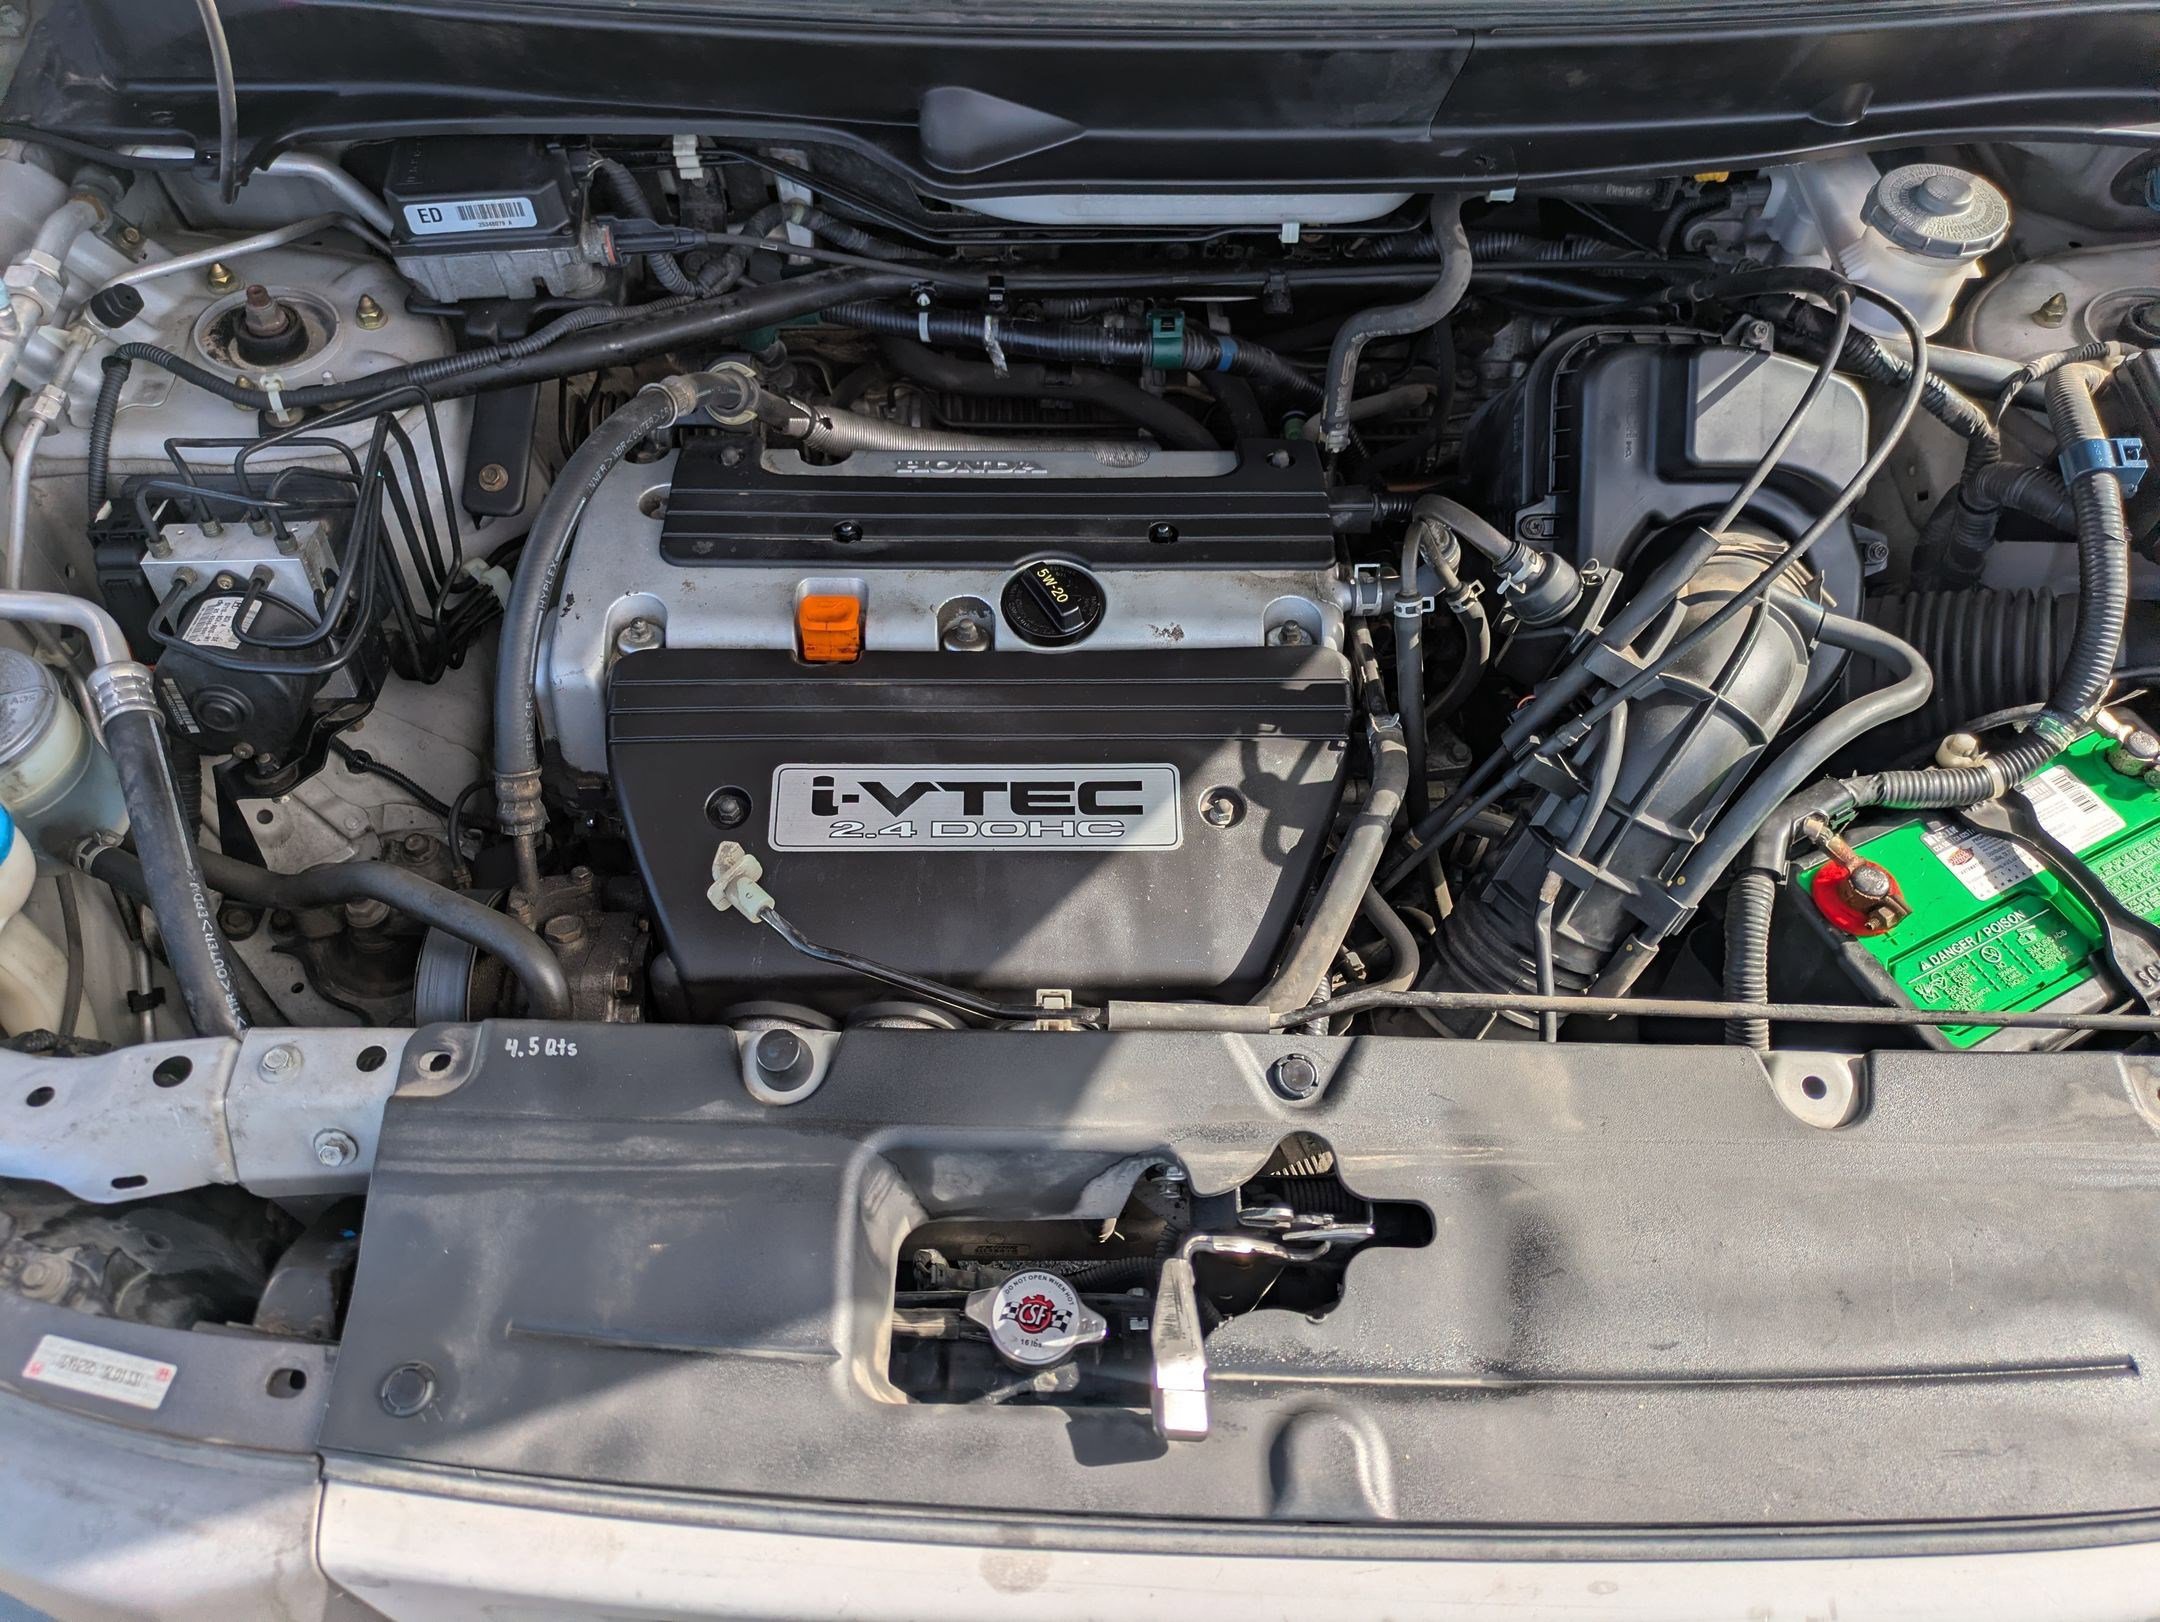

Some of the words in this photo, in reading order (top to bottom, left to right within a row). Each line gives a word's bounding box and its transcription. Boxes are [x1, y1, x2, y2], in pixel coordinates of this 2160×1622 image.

[417, 207, 443, 223] ED
[896, 460, 1048, 474] HONDA
[538, 559, 558, 610] HYPLEX
[1036, 568, 1069, 604] 5W-20
[810, 775, 1144, 818] i-VTEC
[829, 820, 918, 838] 2.4
[931, 820, 1125, 838] DOHC
[1929, 936, 1977, 966] DANGER
[1983, 911, 2026, 937] POISON
[2053, 929, 2068, 940] ACID
[1947, 961, 1969, 977] SHIELD
[1996, 961, 2007, 970] NO
[1944, 974, 1977, 995] EXPLOSIVE
[1952, 970, 1970, 982] EYES
[1950, 987, 1971, 1001] GASES
[545, 1038, 578, 1056] Qts
[1004, 1285, 1015, 1295] DO
[1014, 1276, 1027, 1287] NOT
[1048, 1277, 1067, 1293] WHEN
[1065, 1292, 1075, 1306] HOT
[1018, 1303, 1048, 1325] CSF
[1030, 1340, 1043, 1348] lbs
